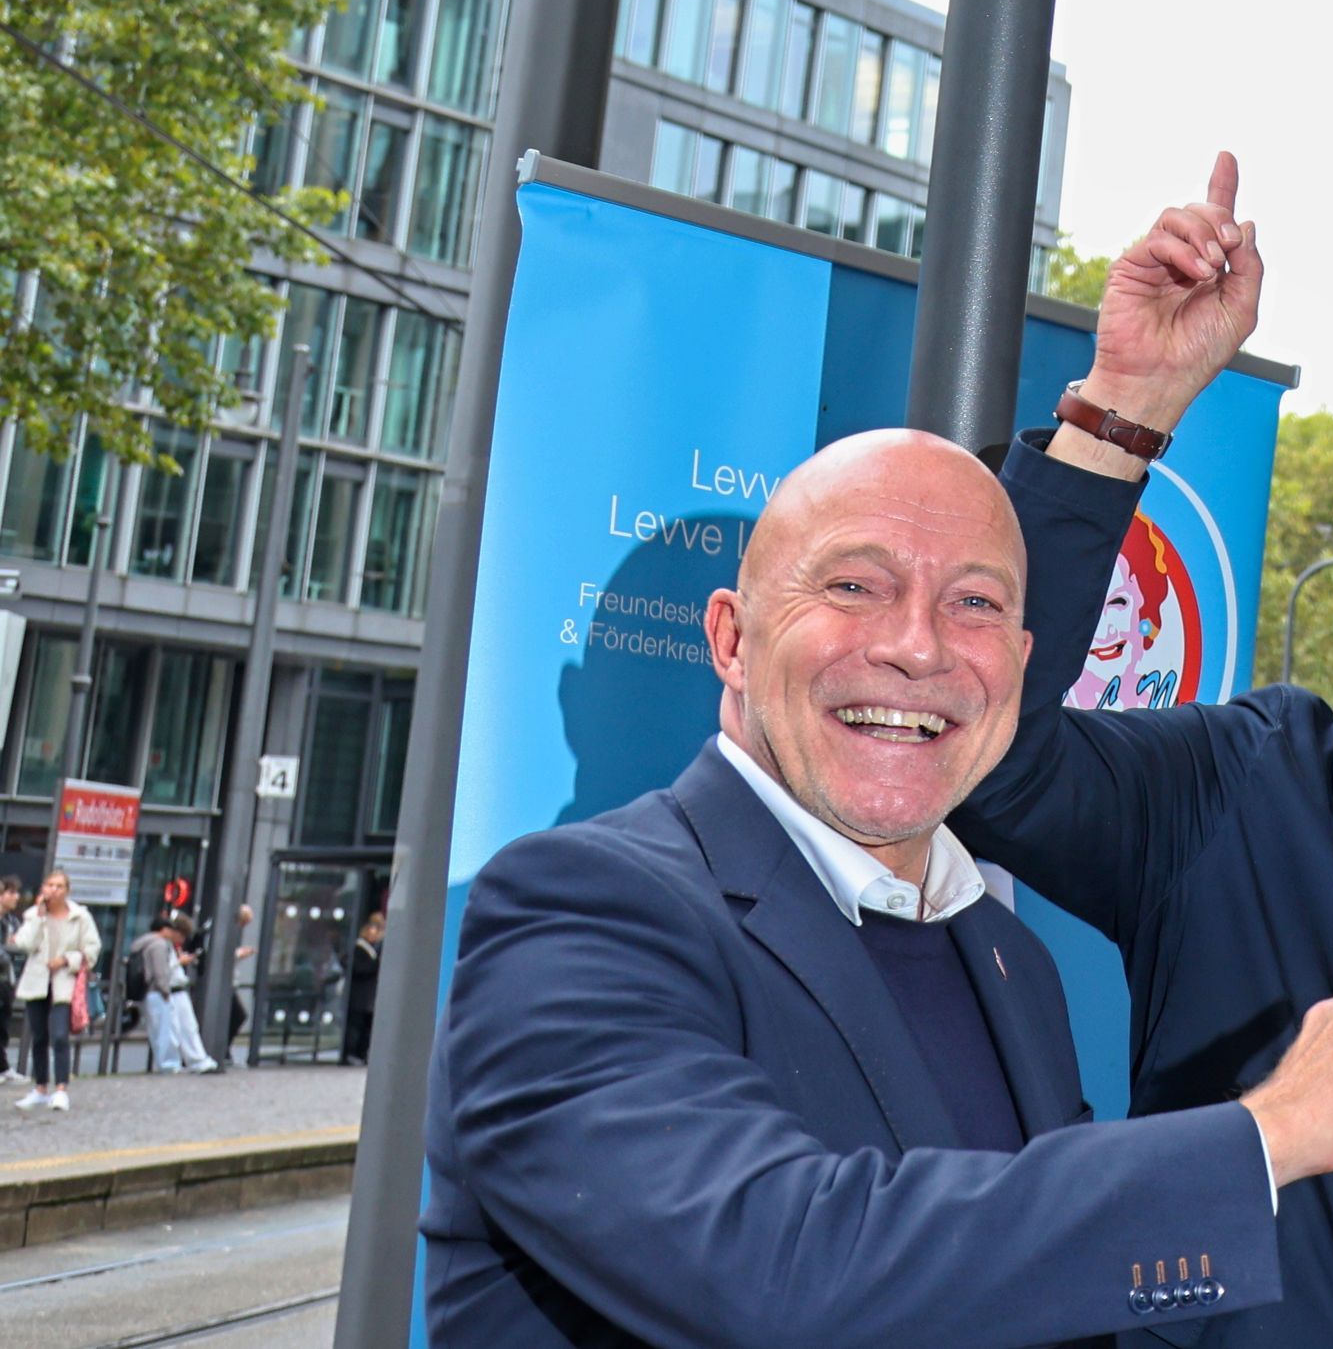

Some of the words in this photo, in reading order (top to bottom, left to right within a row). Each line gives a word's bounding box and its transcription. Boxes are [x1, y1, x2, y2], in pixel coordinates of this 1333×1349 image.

[692, 449, 780, 502] Levv
[609, 495, 722, 555] Levve
[579, 582, 706, 626] Freundesk
[560, 618, 578, 645] &
[271, 769, 288, 791] 4
